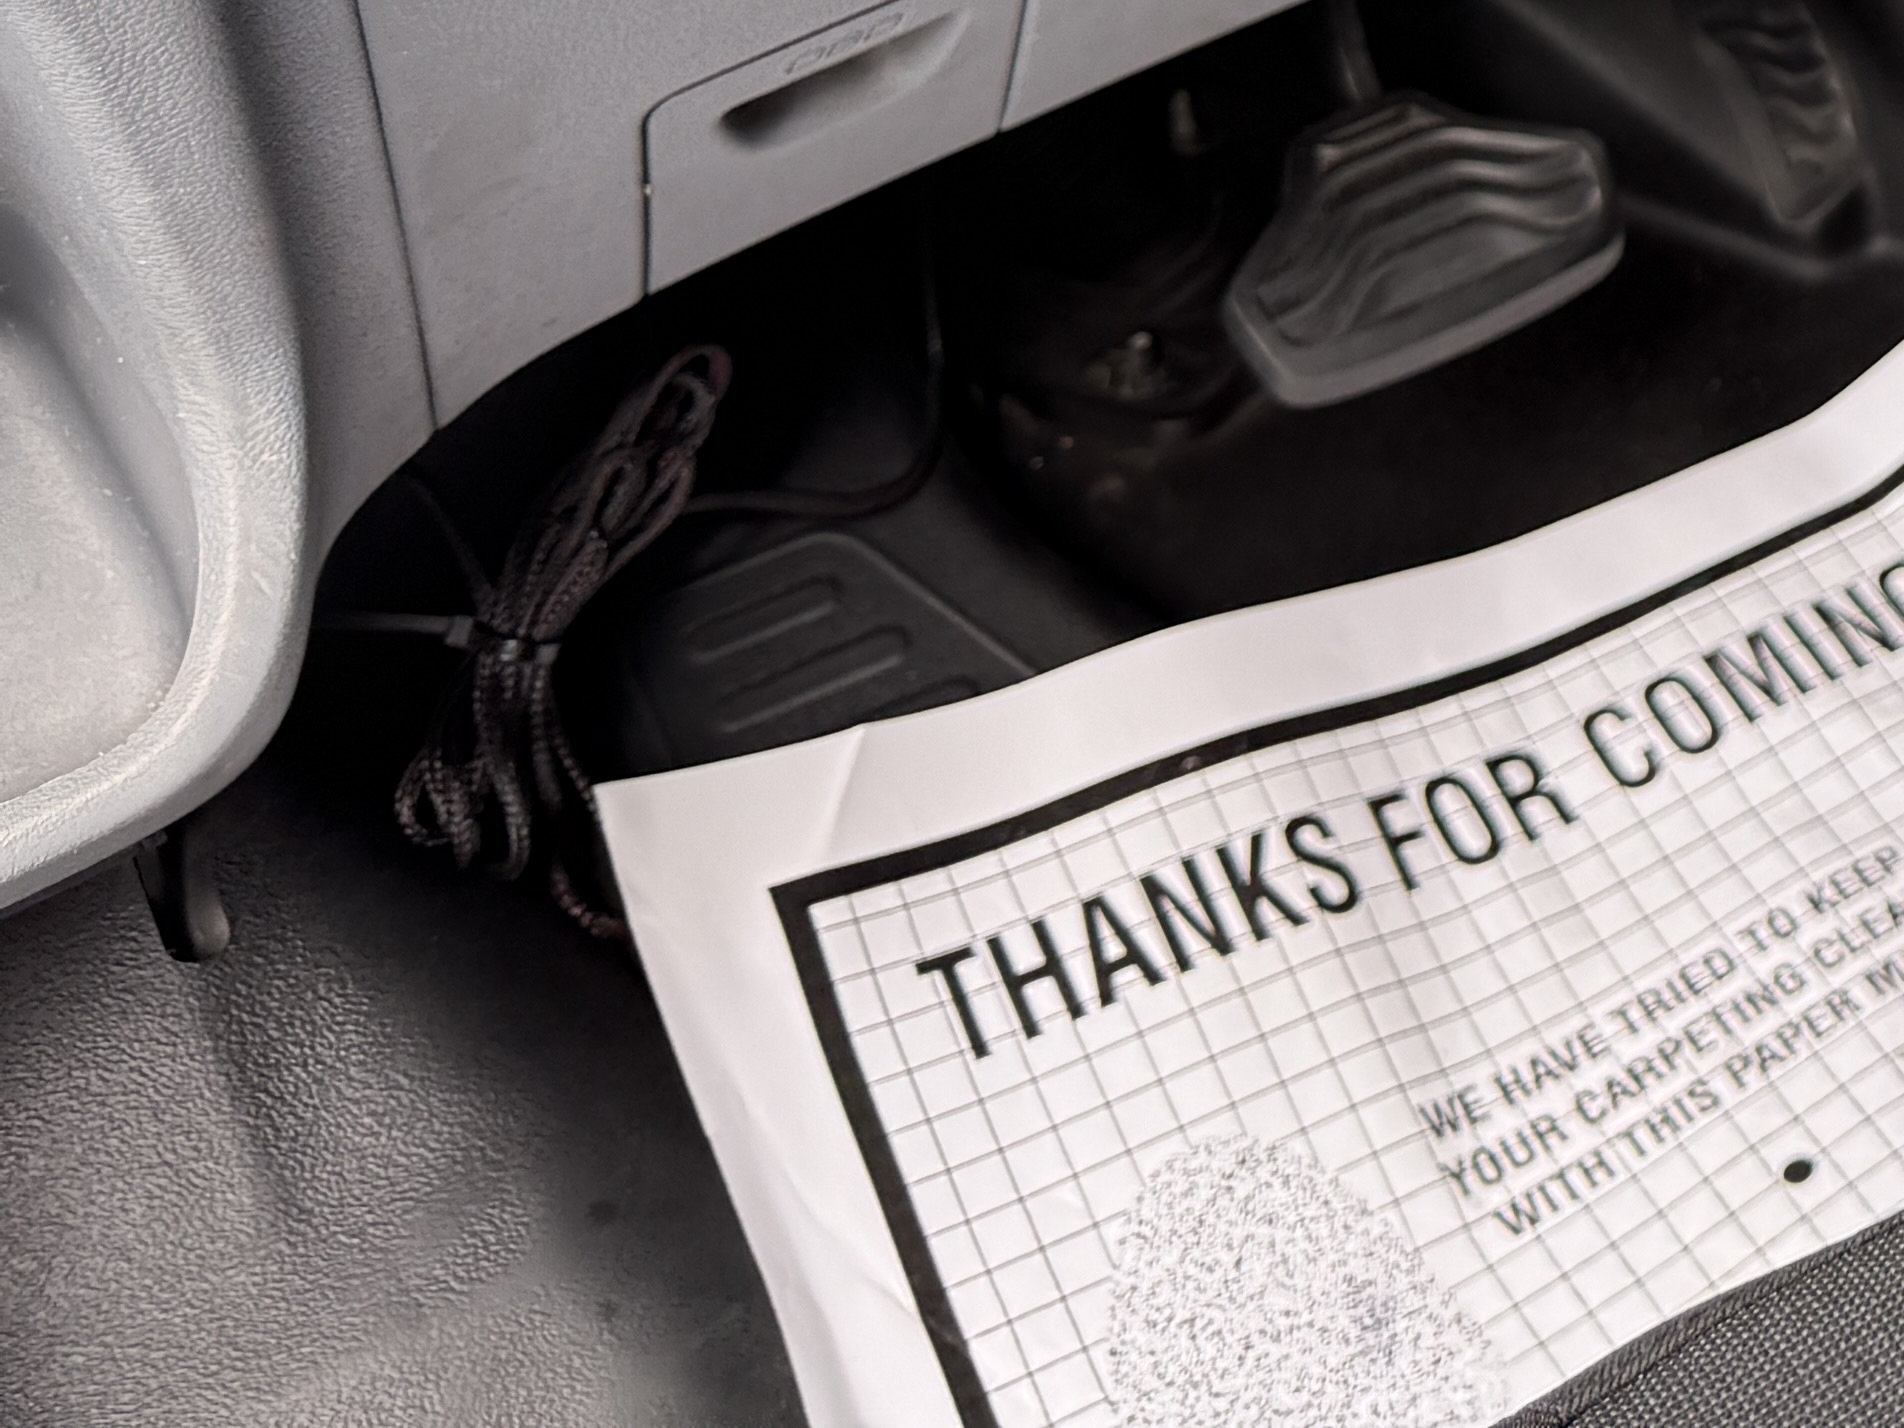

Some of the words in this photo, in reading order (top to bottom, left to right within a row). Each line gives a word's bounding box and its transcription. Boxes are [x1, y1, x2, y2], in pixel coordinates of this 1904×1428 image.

[915, 812, 1359, 1060] THANKS
[1367, 752, 1580, 891] FOR
[1418, 1083, 1491, 1138] WE
[1494, 1022, 1611, 1107] HAVE
[1607, 947, 1738, 1035] TRIED
[1736, 905, 1799, 953] TO
[1803, 843, 1899, 915] KEEP
[1437, 1114, 1569, 1198] YOUR
[1574, 961, 1808, 1126] CARPETING
[1493, 1149, 1616, 1235] WITH
[1617, 1079, 1721, 1158] THIS
[1724, 987, 1861, 1090] PAPER
